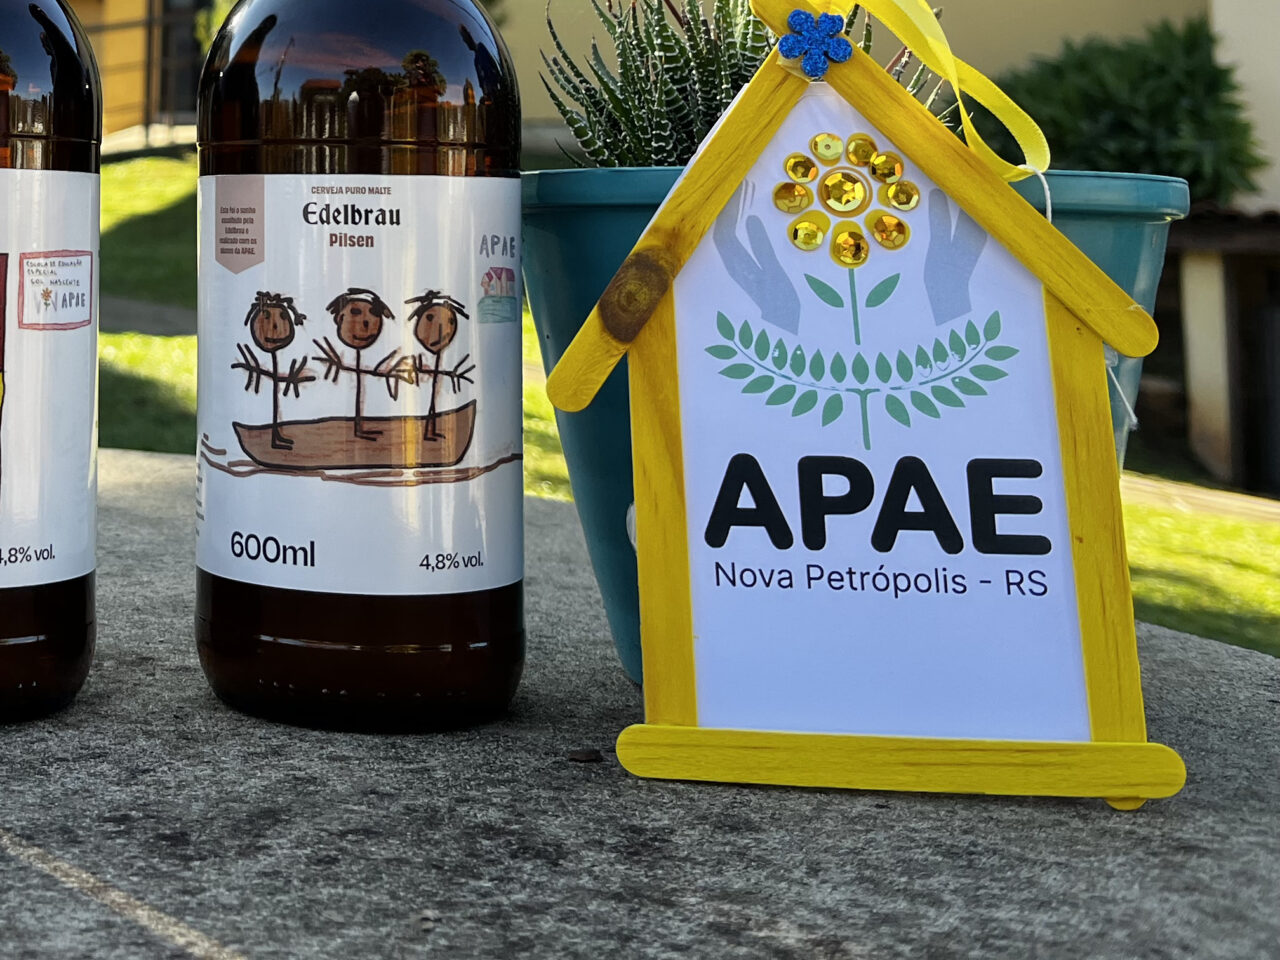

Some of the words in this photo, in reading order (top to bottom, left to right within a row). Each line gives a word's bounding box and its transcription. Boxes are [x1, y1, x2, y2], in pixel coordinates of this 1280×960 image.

[311, 186, 344, 195] CERVEJA
[345, 186, 366, 195] PURO
[368, 186, 392, 195] MALTE
[302, 201, 401, 227] Edelbrau
[329, 232, 375, 248] Pilsen
[479, 234, 516, 258] APAE
[26, 260, 49, 268] ESCOLA
[27, 268, 58, 276] ESPECIAL
[61, 291, 86, 309] APAE
[704, 452, 1053, 555] APAE
[34, 543, 56, 561] vol.
[230, 530, 316, 567] 600ml
[419, 551, 460, 573] 4,8%
[462, 551, 485, 568] vol.
[714, 561, 794, 589] Nova
[806, 562, 968, 599] Petrópolis
[1004, 569, 1049, 597] RS
